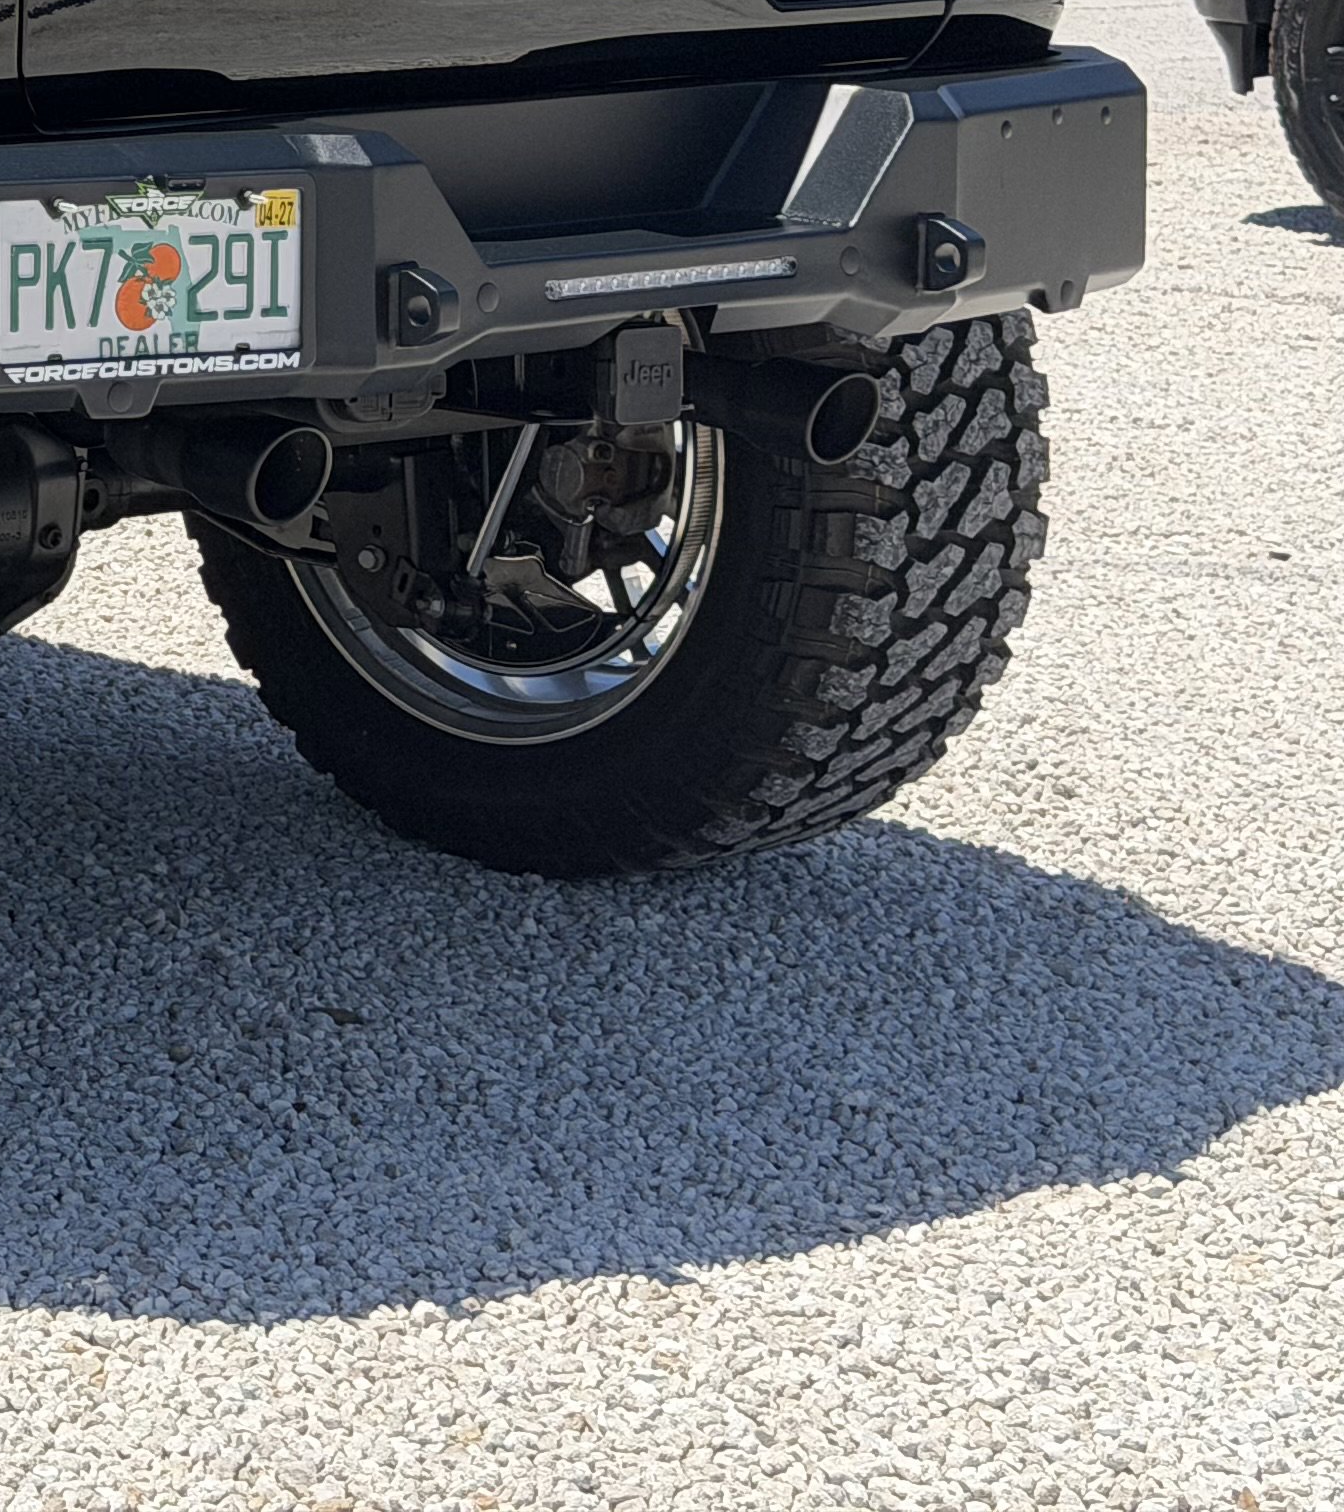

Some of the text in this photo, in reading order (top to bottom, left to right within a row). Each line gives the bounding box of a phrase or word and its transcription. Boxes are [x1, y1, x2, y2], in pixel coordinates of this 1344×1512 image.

[112, 195, 198, 213] FORCE
[9, 236, 115, 333] PK7
[98, 332, 199, 358] DEALER
[3, 352, 301, 384] FORCECUSTOMS.COM
[623, 359, 674, 388] Jeep
